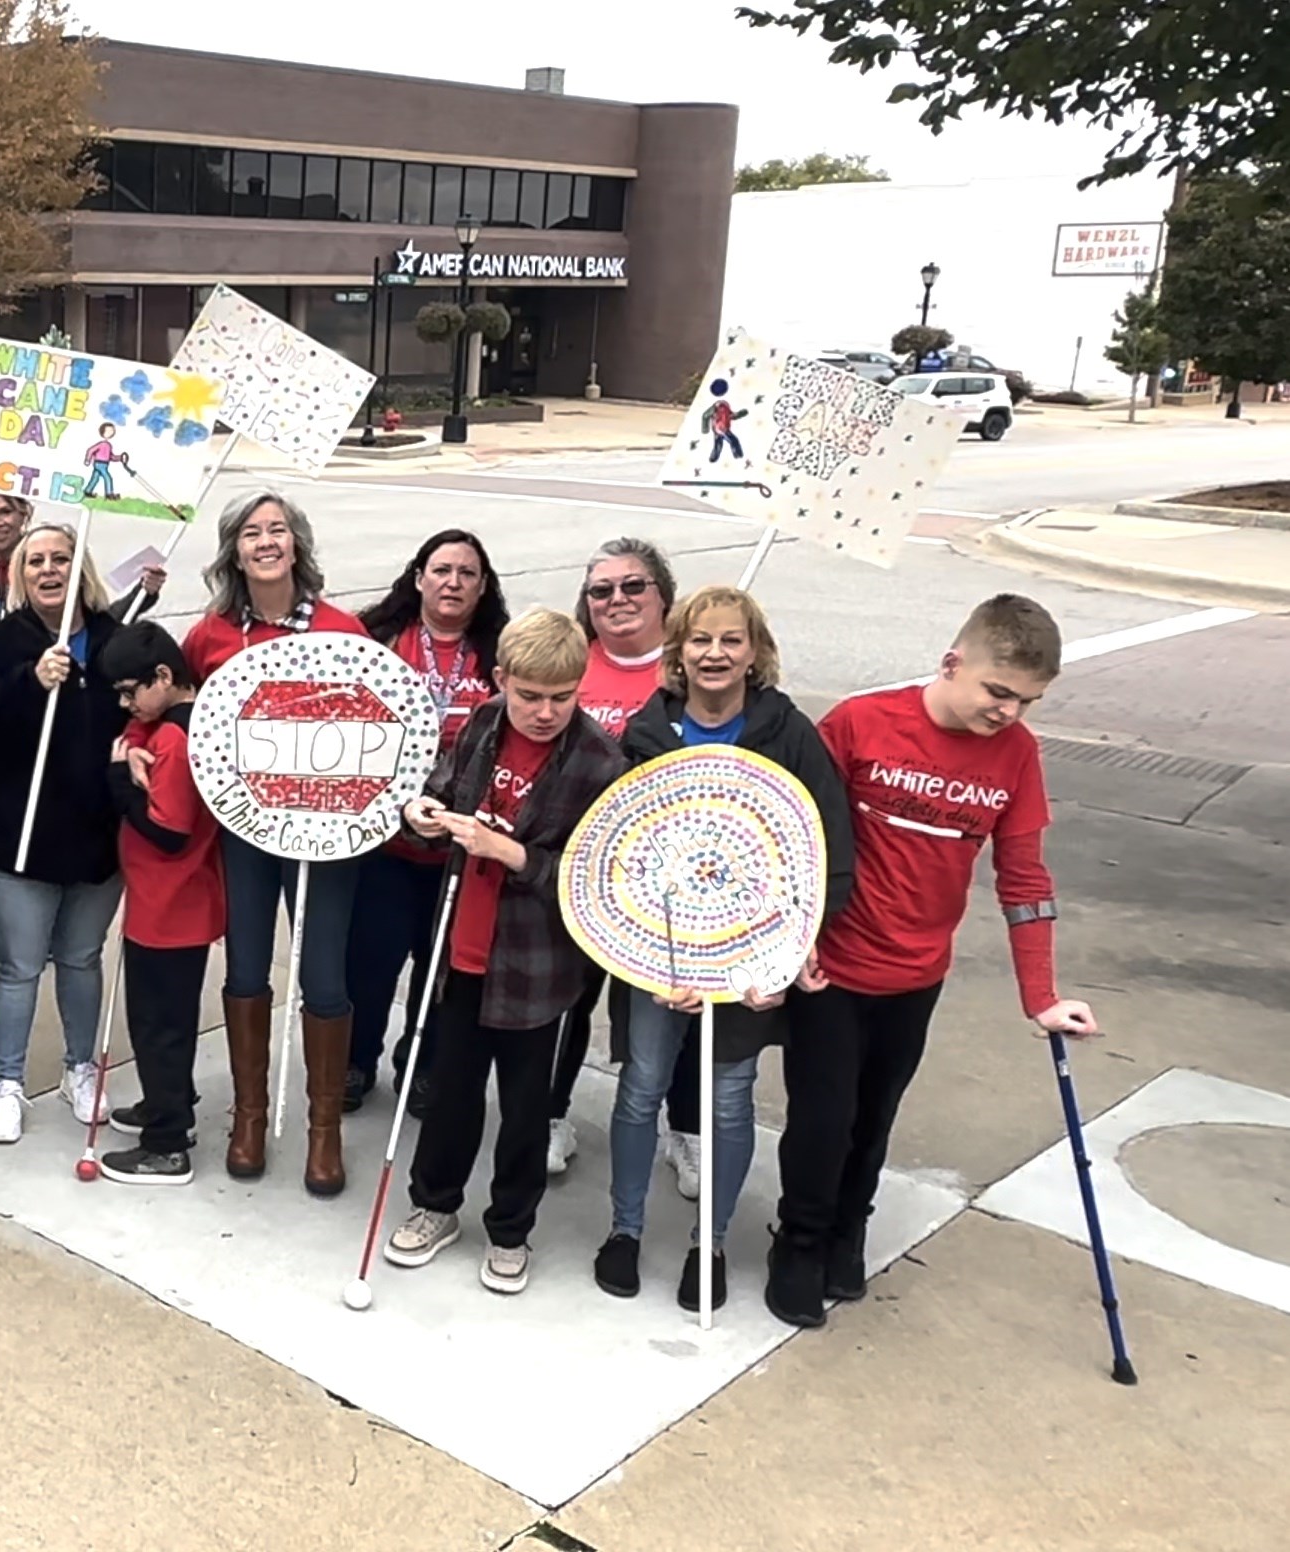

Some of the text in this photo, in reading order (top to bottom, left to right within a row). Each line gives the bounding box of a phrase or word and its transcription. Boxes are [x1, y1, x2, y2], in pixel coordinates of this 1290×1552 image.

[1063, 246, 1150, 263] HARDWARE
[1077, 229, 1140, 243] WENZL
[508, 254, 583, 277] NATIONAL
[585, 257, 626, 278] BANK
[779, 354, 905, 428] WHITE
[772, 393, 881, 457] CANE
[766, 428, 851, 481] DAY
[243, 720, 387, 776] STOP
[211, 779, 269, 845] White
[278, 820, 337, 857] Cane
